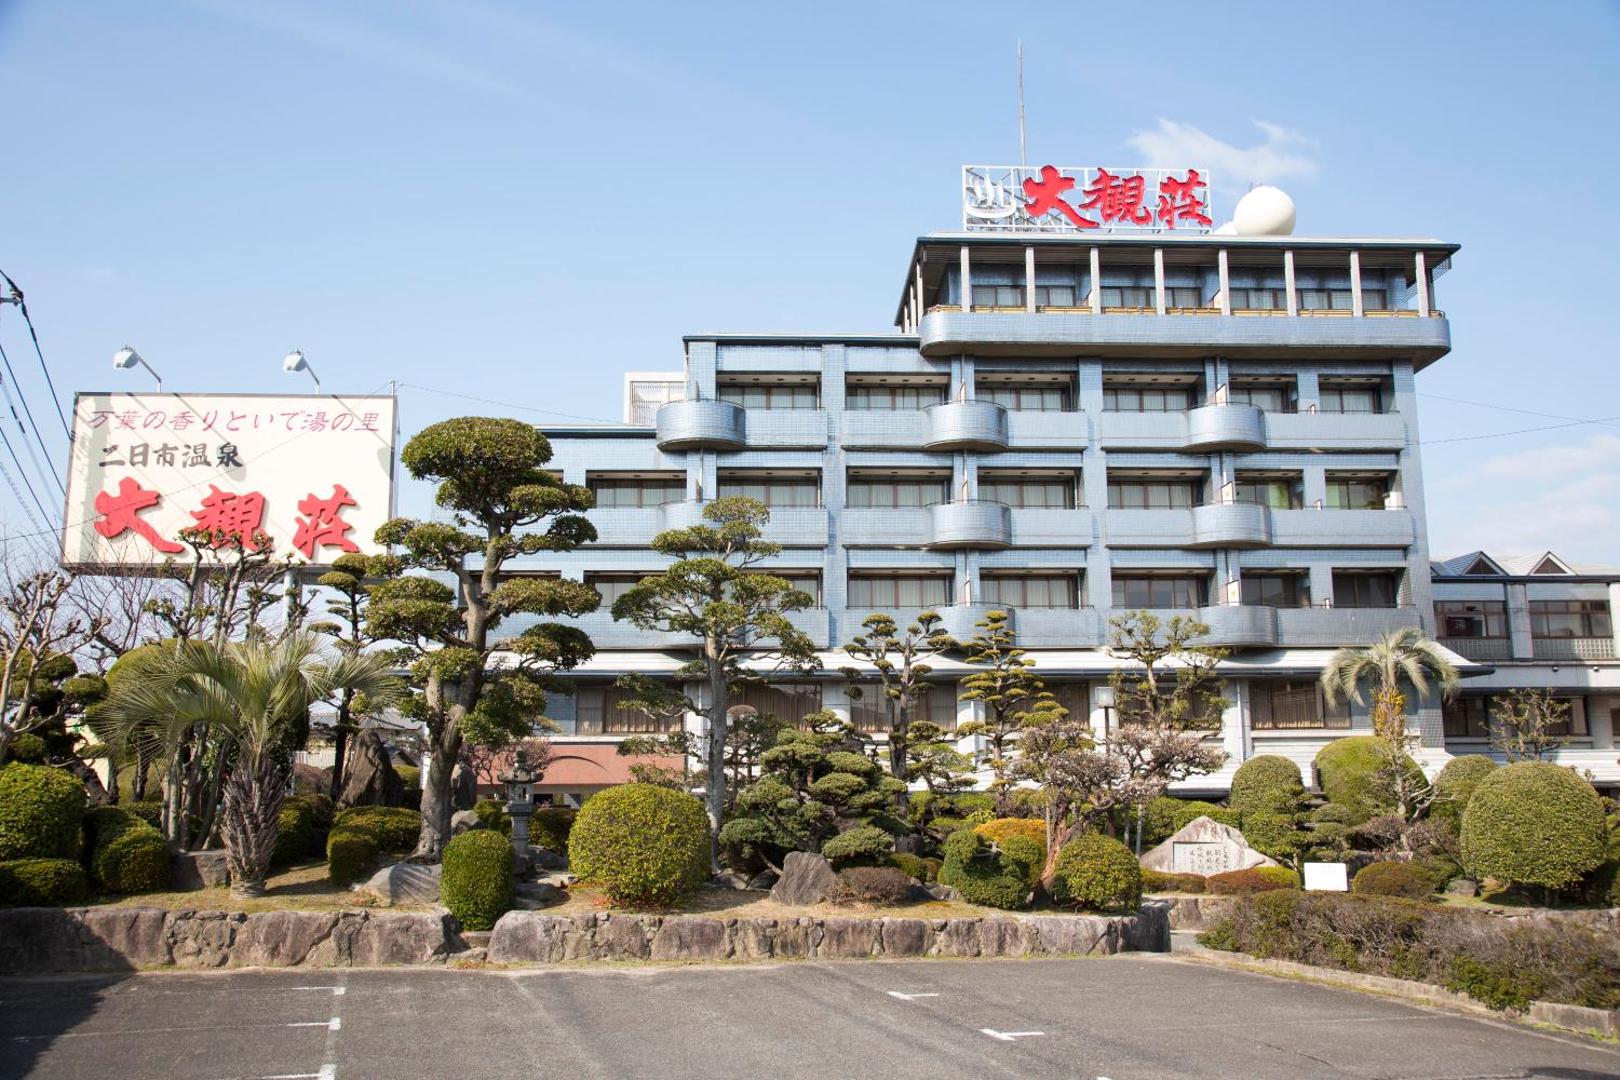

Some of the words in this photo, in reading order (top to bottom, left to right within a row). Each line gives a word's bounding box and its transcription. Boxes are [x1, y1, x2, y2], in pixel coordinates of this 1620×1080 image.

[1023, 165, 1213, 230] 大観荘
[89, 410, 379, 432] 万葉の香りといで湯の里
[99, 442, 243, 468] 二日市温泉
[94, 476, 361, 559] 大観荘
